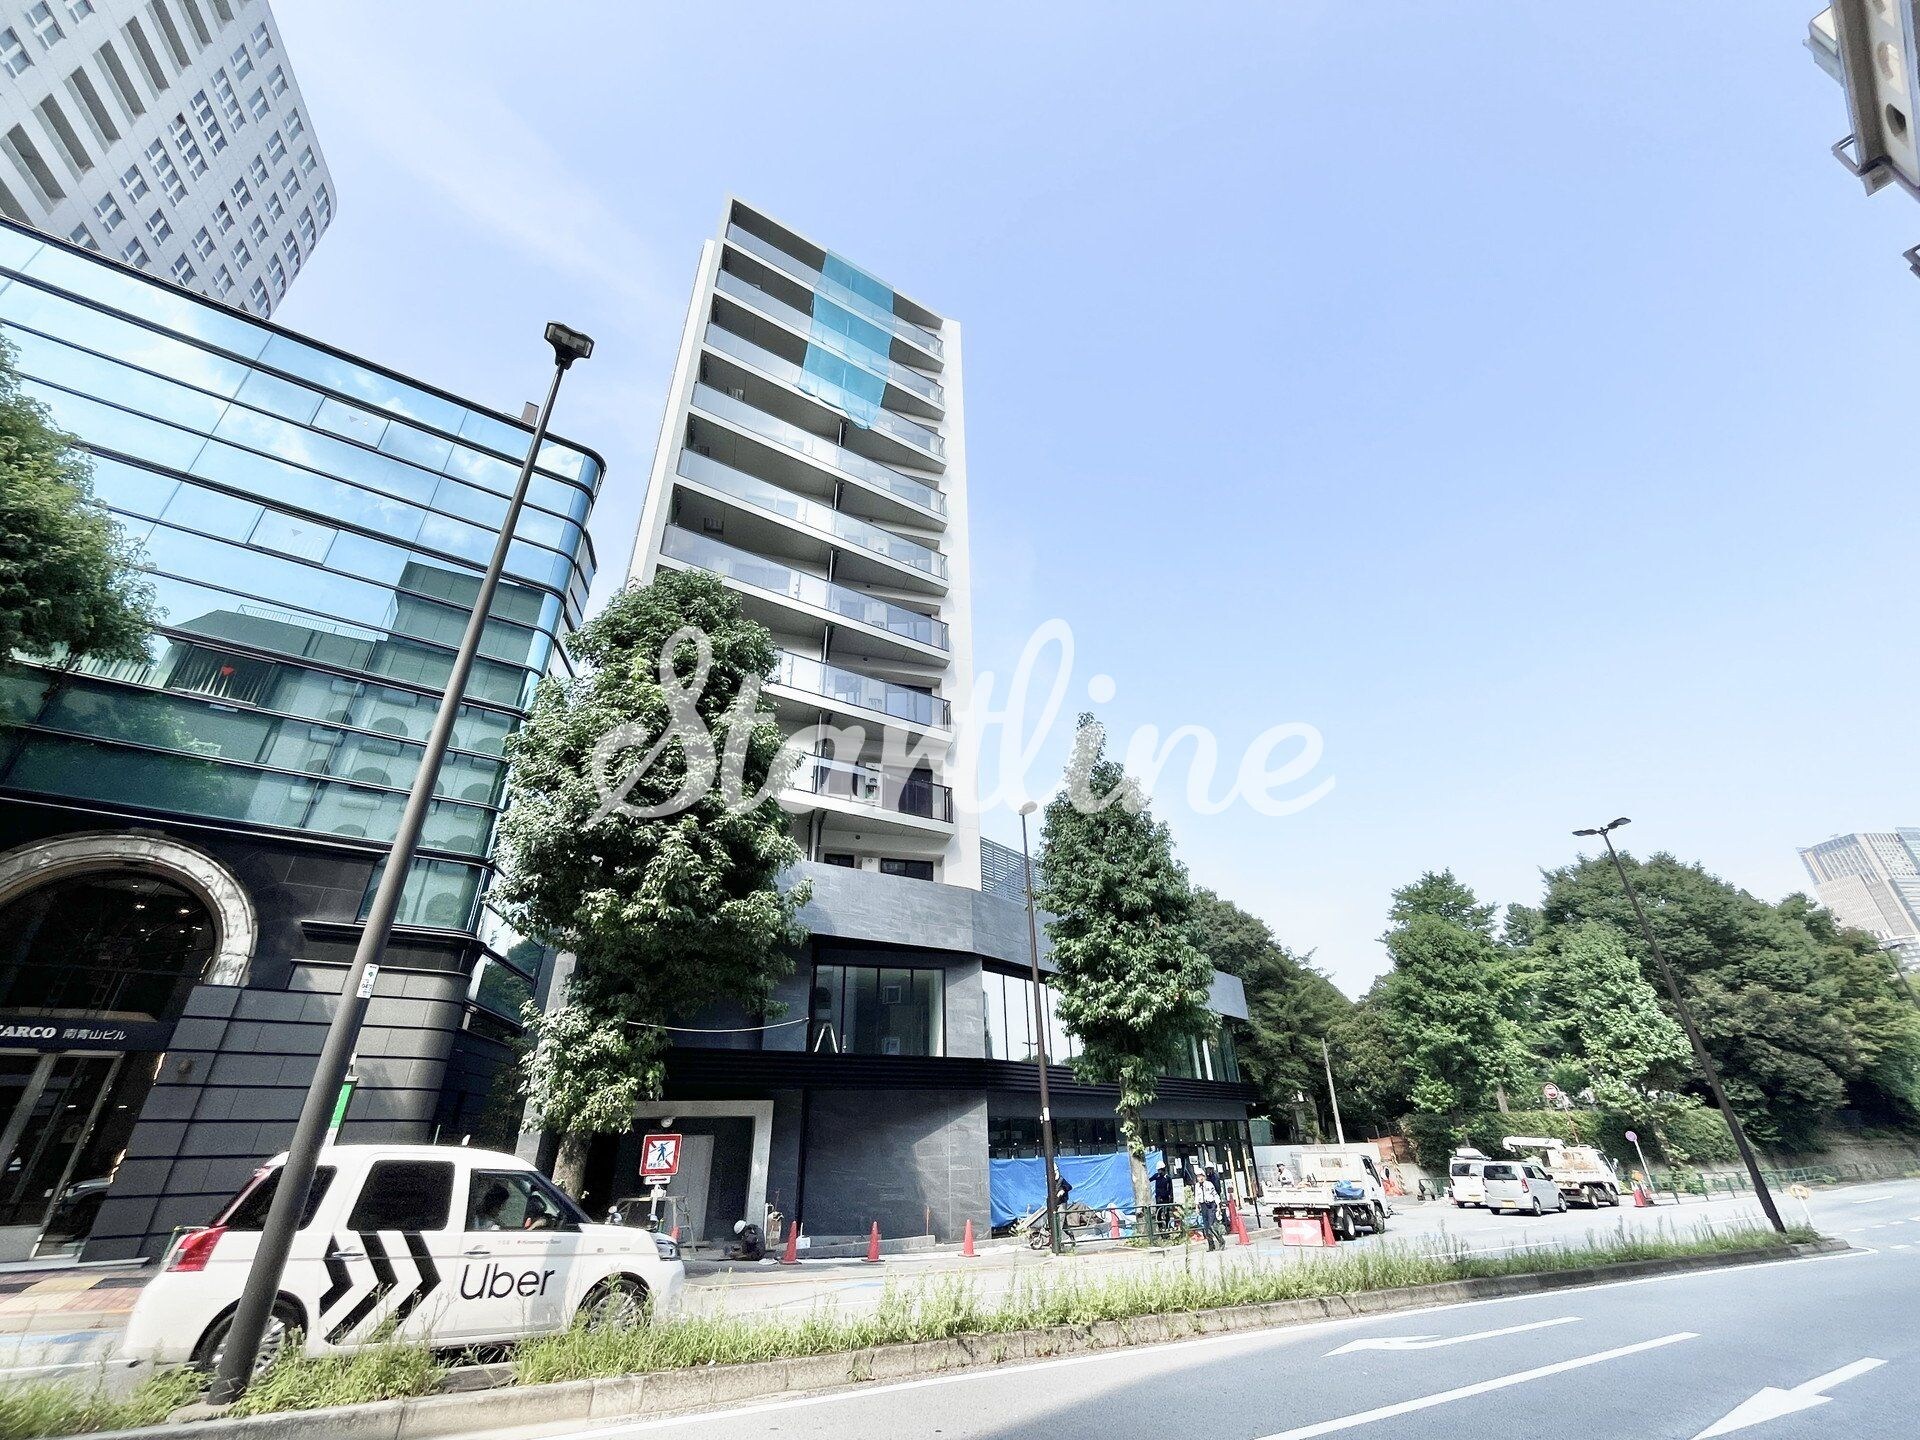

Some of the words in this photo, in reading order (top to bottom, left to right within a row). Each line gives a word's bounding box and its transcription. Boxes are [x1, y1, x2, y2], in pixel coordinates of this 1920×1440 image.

[62, 1028, 127, 1040] 南青山ビル
[460, 1263, 556, 1300] Uber
